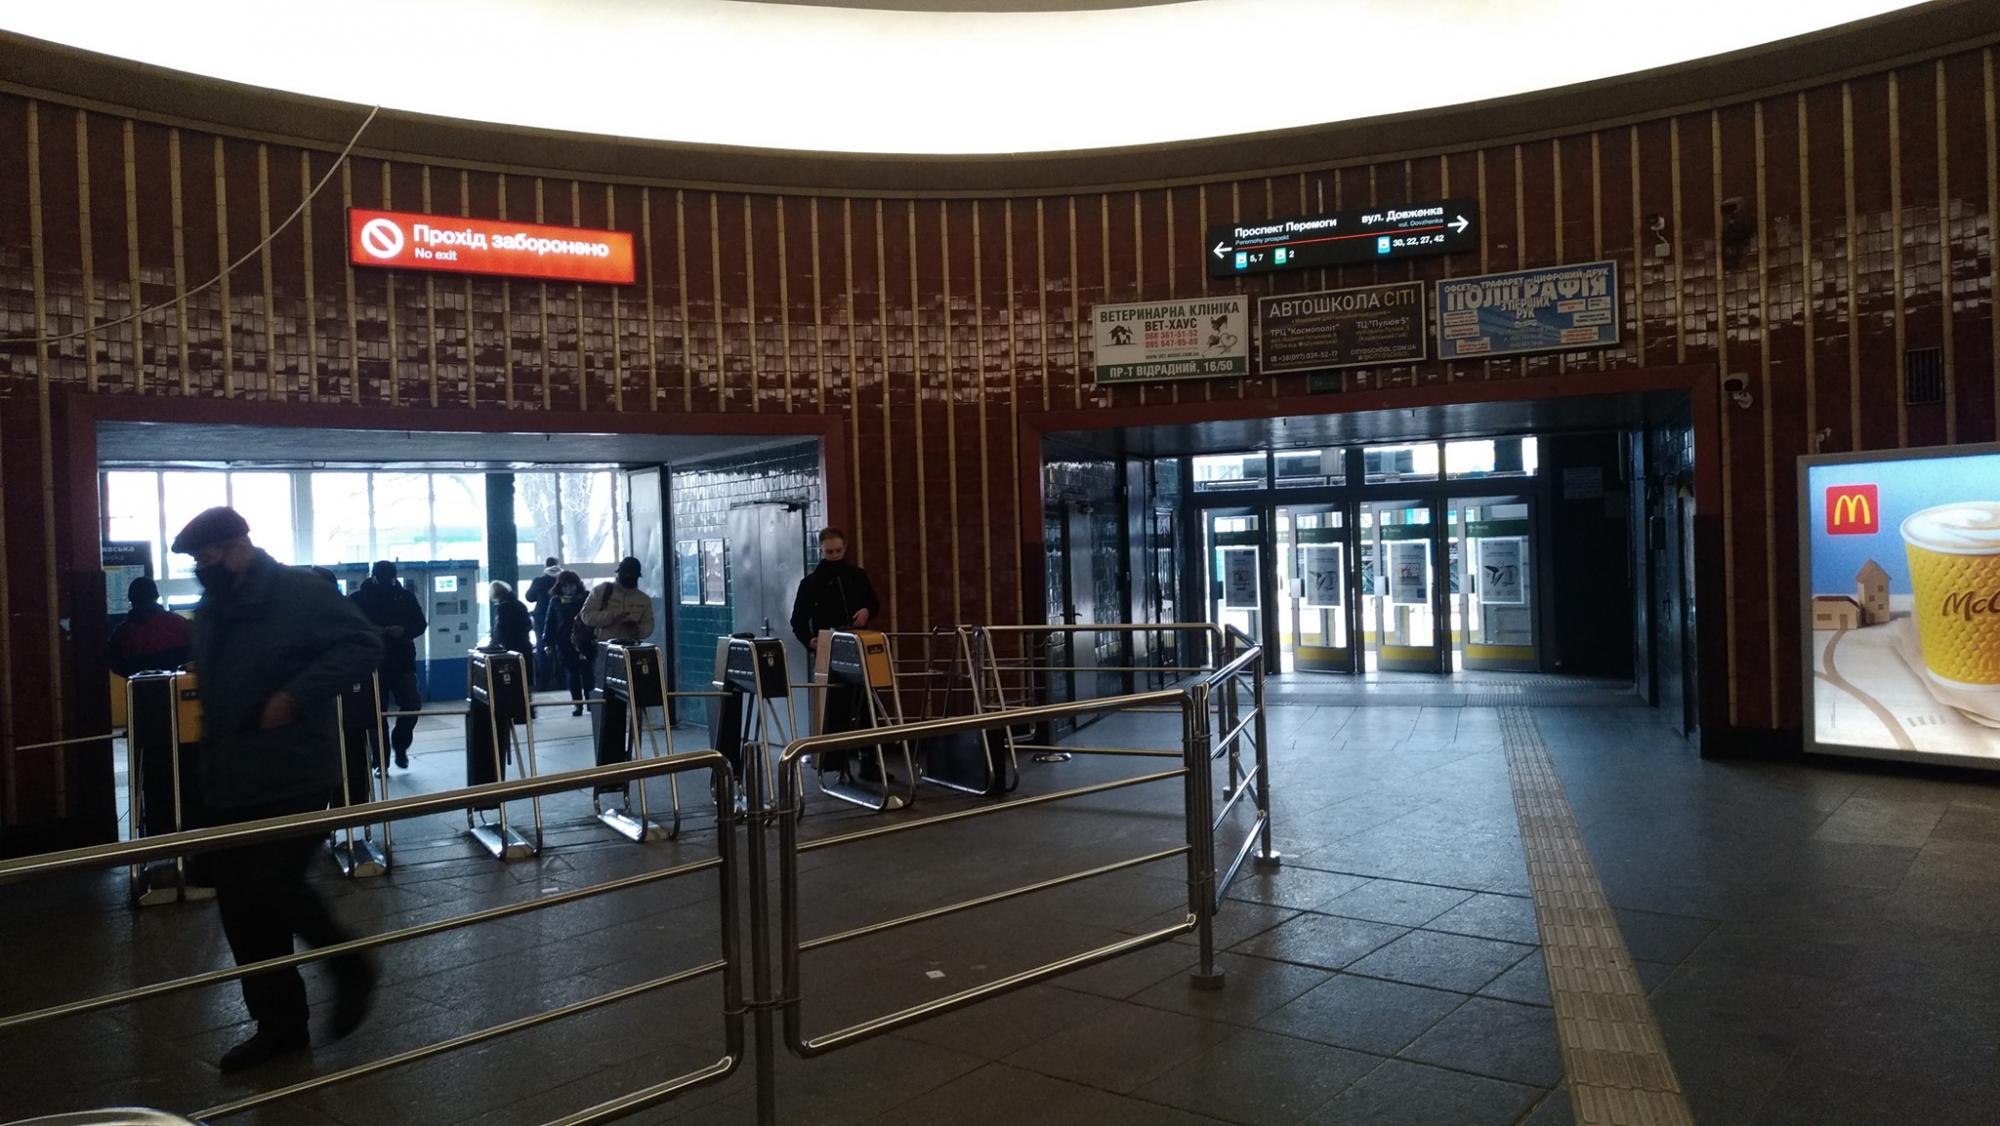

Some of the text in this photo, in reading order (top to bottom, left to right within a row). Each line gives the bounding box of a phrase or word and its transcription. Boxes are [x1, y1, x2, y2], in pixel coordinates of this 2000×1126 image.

[1361, 207, 1444, 225] вул. Довженка
[1234, 219, 1337, 239] Проспект Перемоги
[1434, 234, 1444, 242] 42
[413, 224, 609, 257] Прохід заборонено
[415, 247, 457, 261] No exit
[1289, 250, 1295, 258] 2
[1481, 277, 1525, 289] ТРАФАРЕТ
[1533, 269, 1583, 285] ЦИФРОВИЙ
[1447, 276, 1607, 311] ПОЛІГРАФІЯ
[1100, 301, 1240, 323] ВЕТЕРИНАРНА КЛІНІКА
[1269, 293, 1381, 318] АВТОШКОЛА
[1384, 289, 1415, 307] СІТІ
[1507, 296, 1550, 310] ПЕРШИХ
[1516, 308, 1535, 319] РУК
[1144, 318, 1198, 332] ВЕТ-ХАУС
[1271, 328, 1286, 336] ТРЦ
[1110, 366, 1134, 378] ПР-Т
[1204, 360, 1233, 372] 16/50
